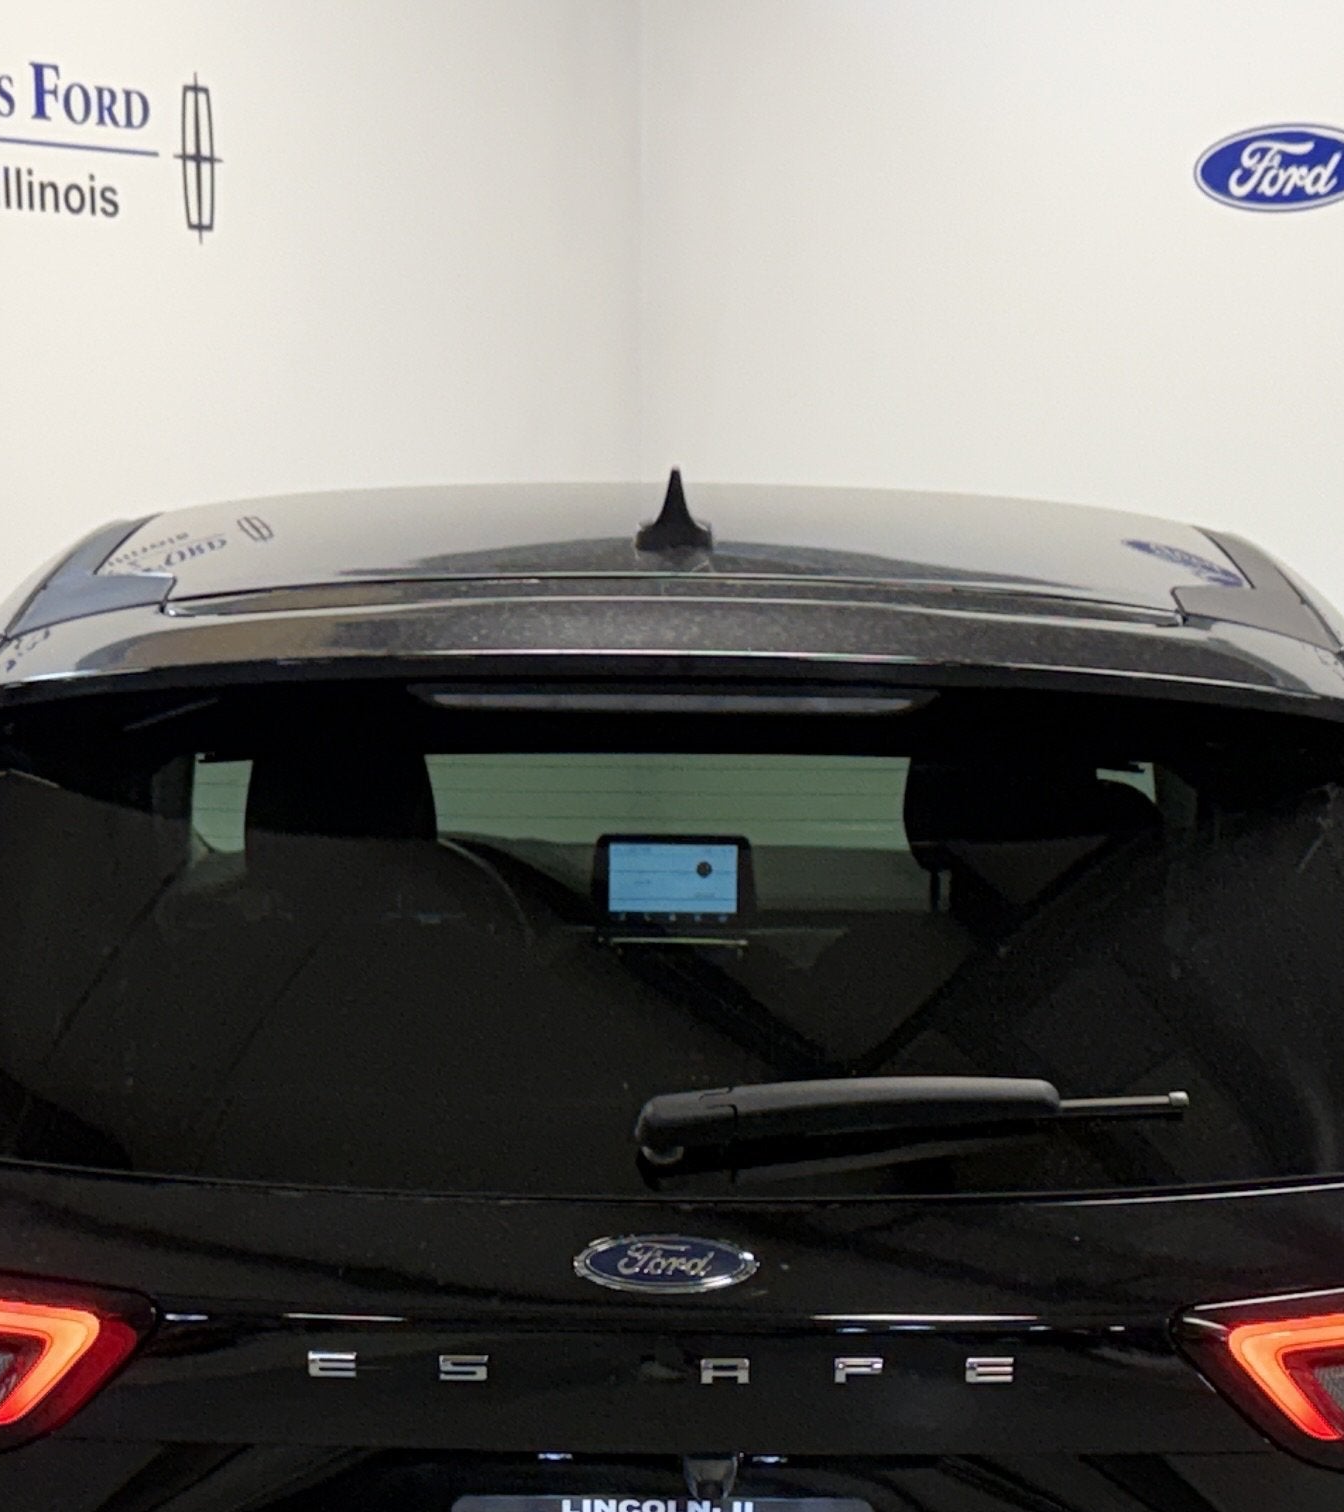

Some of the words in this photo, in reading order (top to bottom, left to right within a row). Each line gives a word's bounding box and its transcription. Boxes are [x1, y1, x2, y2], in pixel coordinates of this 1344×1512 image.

[29, 61, 151, 130] FORD
[1228, 140, 1337, 198] Ford
[617, 1242, 714, 1275] Ford
[308, 1351, 1014, 1384] ESAPE
